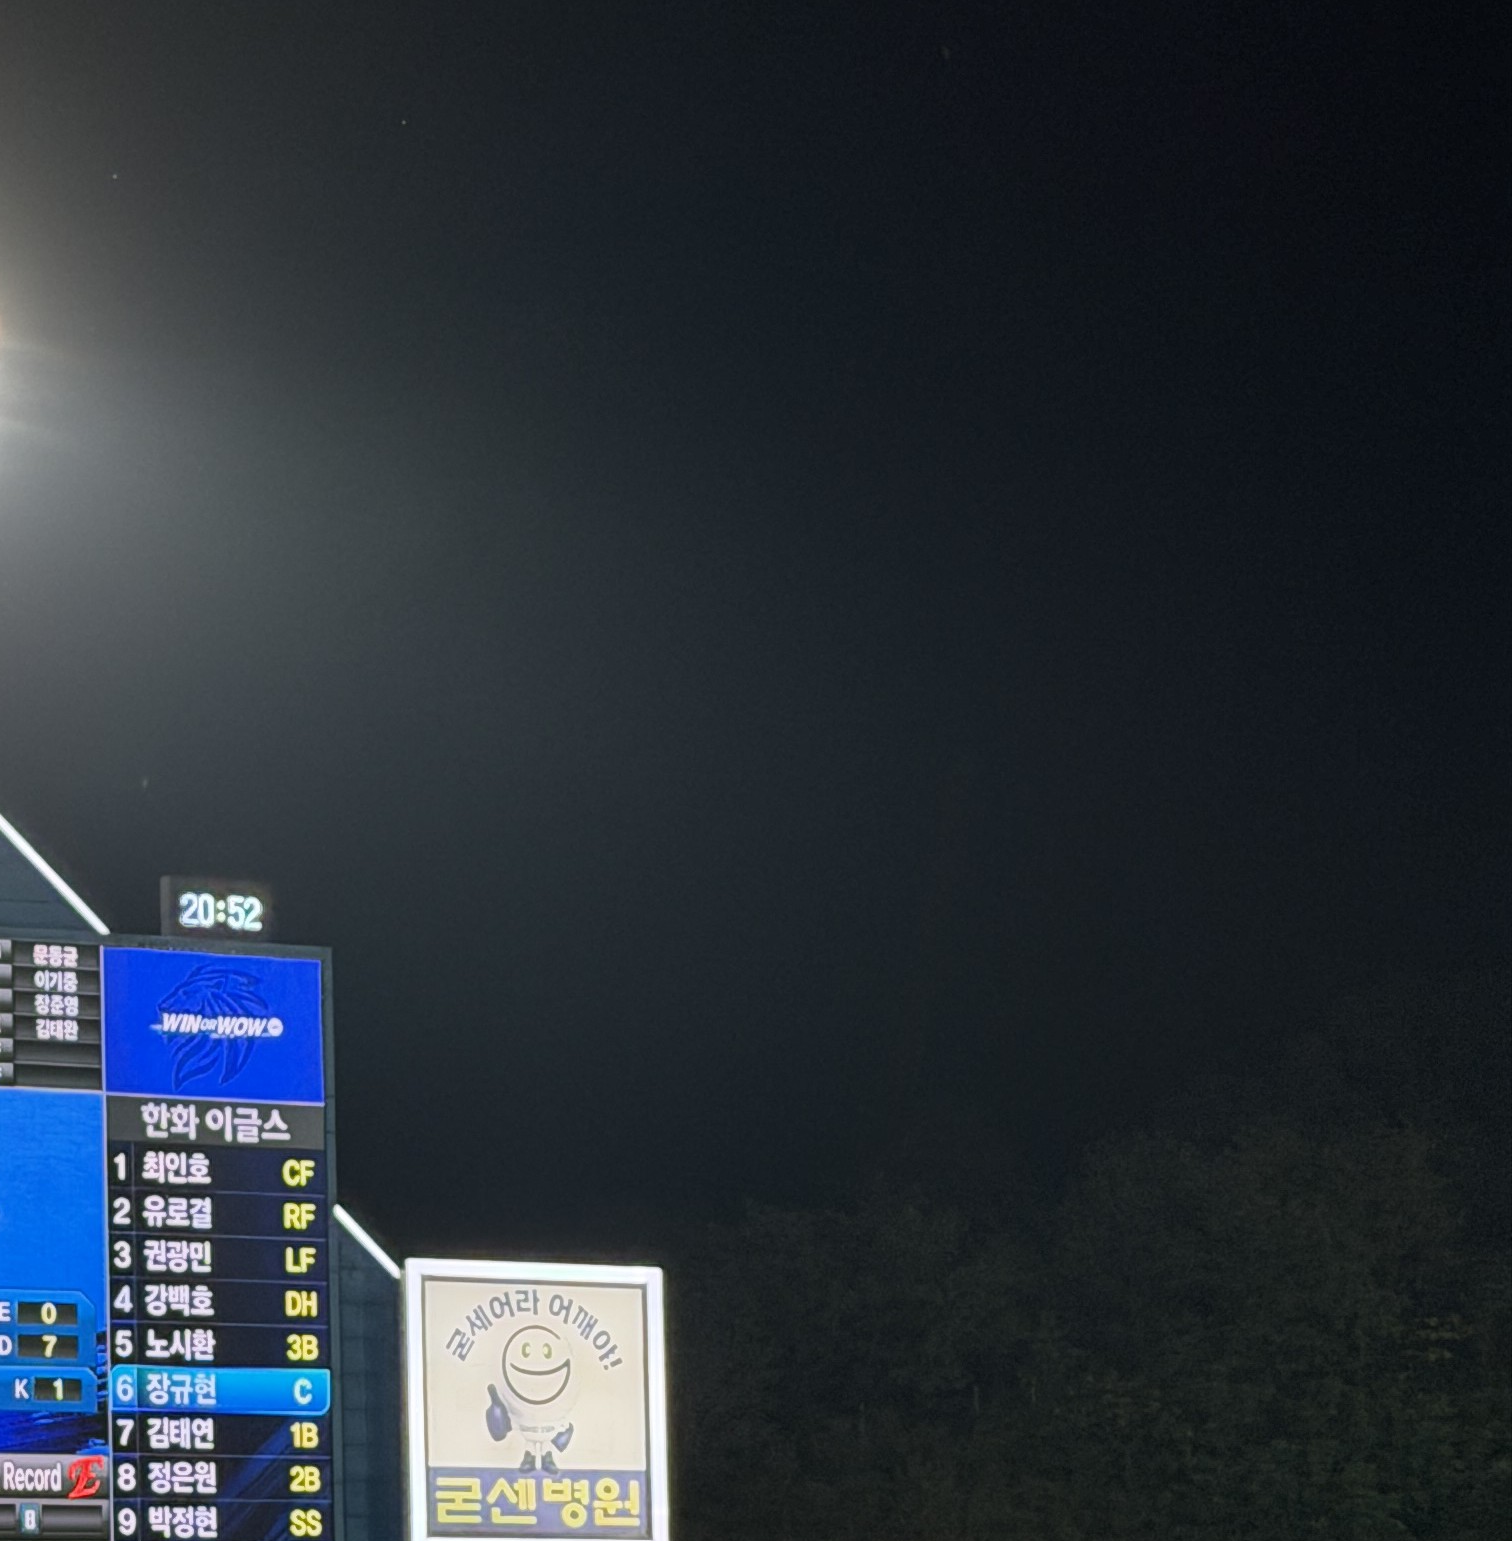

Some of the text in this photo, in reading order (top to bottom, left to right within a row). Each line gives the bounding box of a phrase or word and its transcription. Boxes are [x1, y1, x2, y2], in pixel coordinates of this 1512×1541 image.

[179, 892, 262, 932] 20:52
[161, 1012, 202, 1034] WIN
[215, 1015, 268, 1037] WOW
[140, 1101, 291, 1143] 한화 이글스
[142, 1150, 316, 1187] 최인호 CF
[142, 1195, 316, 1230] 유로결 RF
[143, 1239, 316, 1273] 권광민 LF
[41, 1302, 57, 1325] 0
[144, 1284, 318, 1318] 강백호 DH
[42, 1335, 56, 1357] 7
[145, 1329, 319, 1361] 노시환 3B
[445, 1288, 624, 1371] 굳세어라 어깨야!
[14, 1378, 30, 1399] K
[53, 1378, 64, 1400] 1
[146, 1373, 313, 1405] 장규현 C
[147, 1417, 319, 1450] 김태연 1B
[3, 1461, 62, 1491] Record
[147, 1461, 321, 1494] 정은원 2B
[435, 1476, 641, 1529] 굳센병원
[148, 1505, 323, 1539] 박정현 SS
